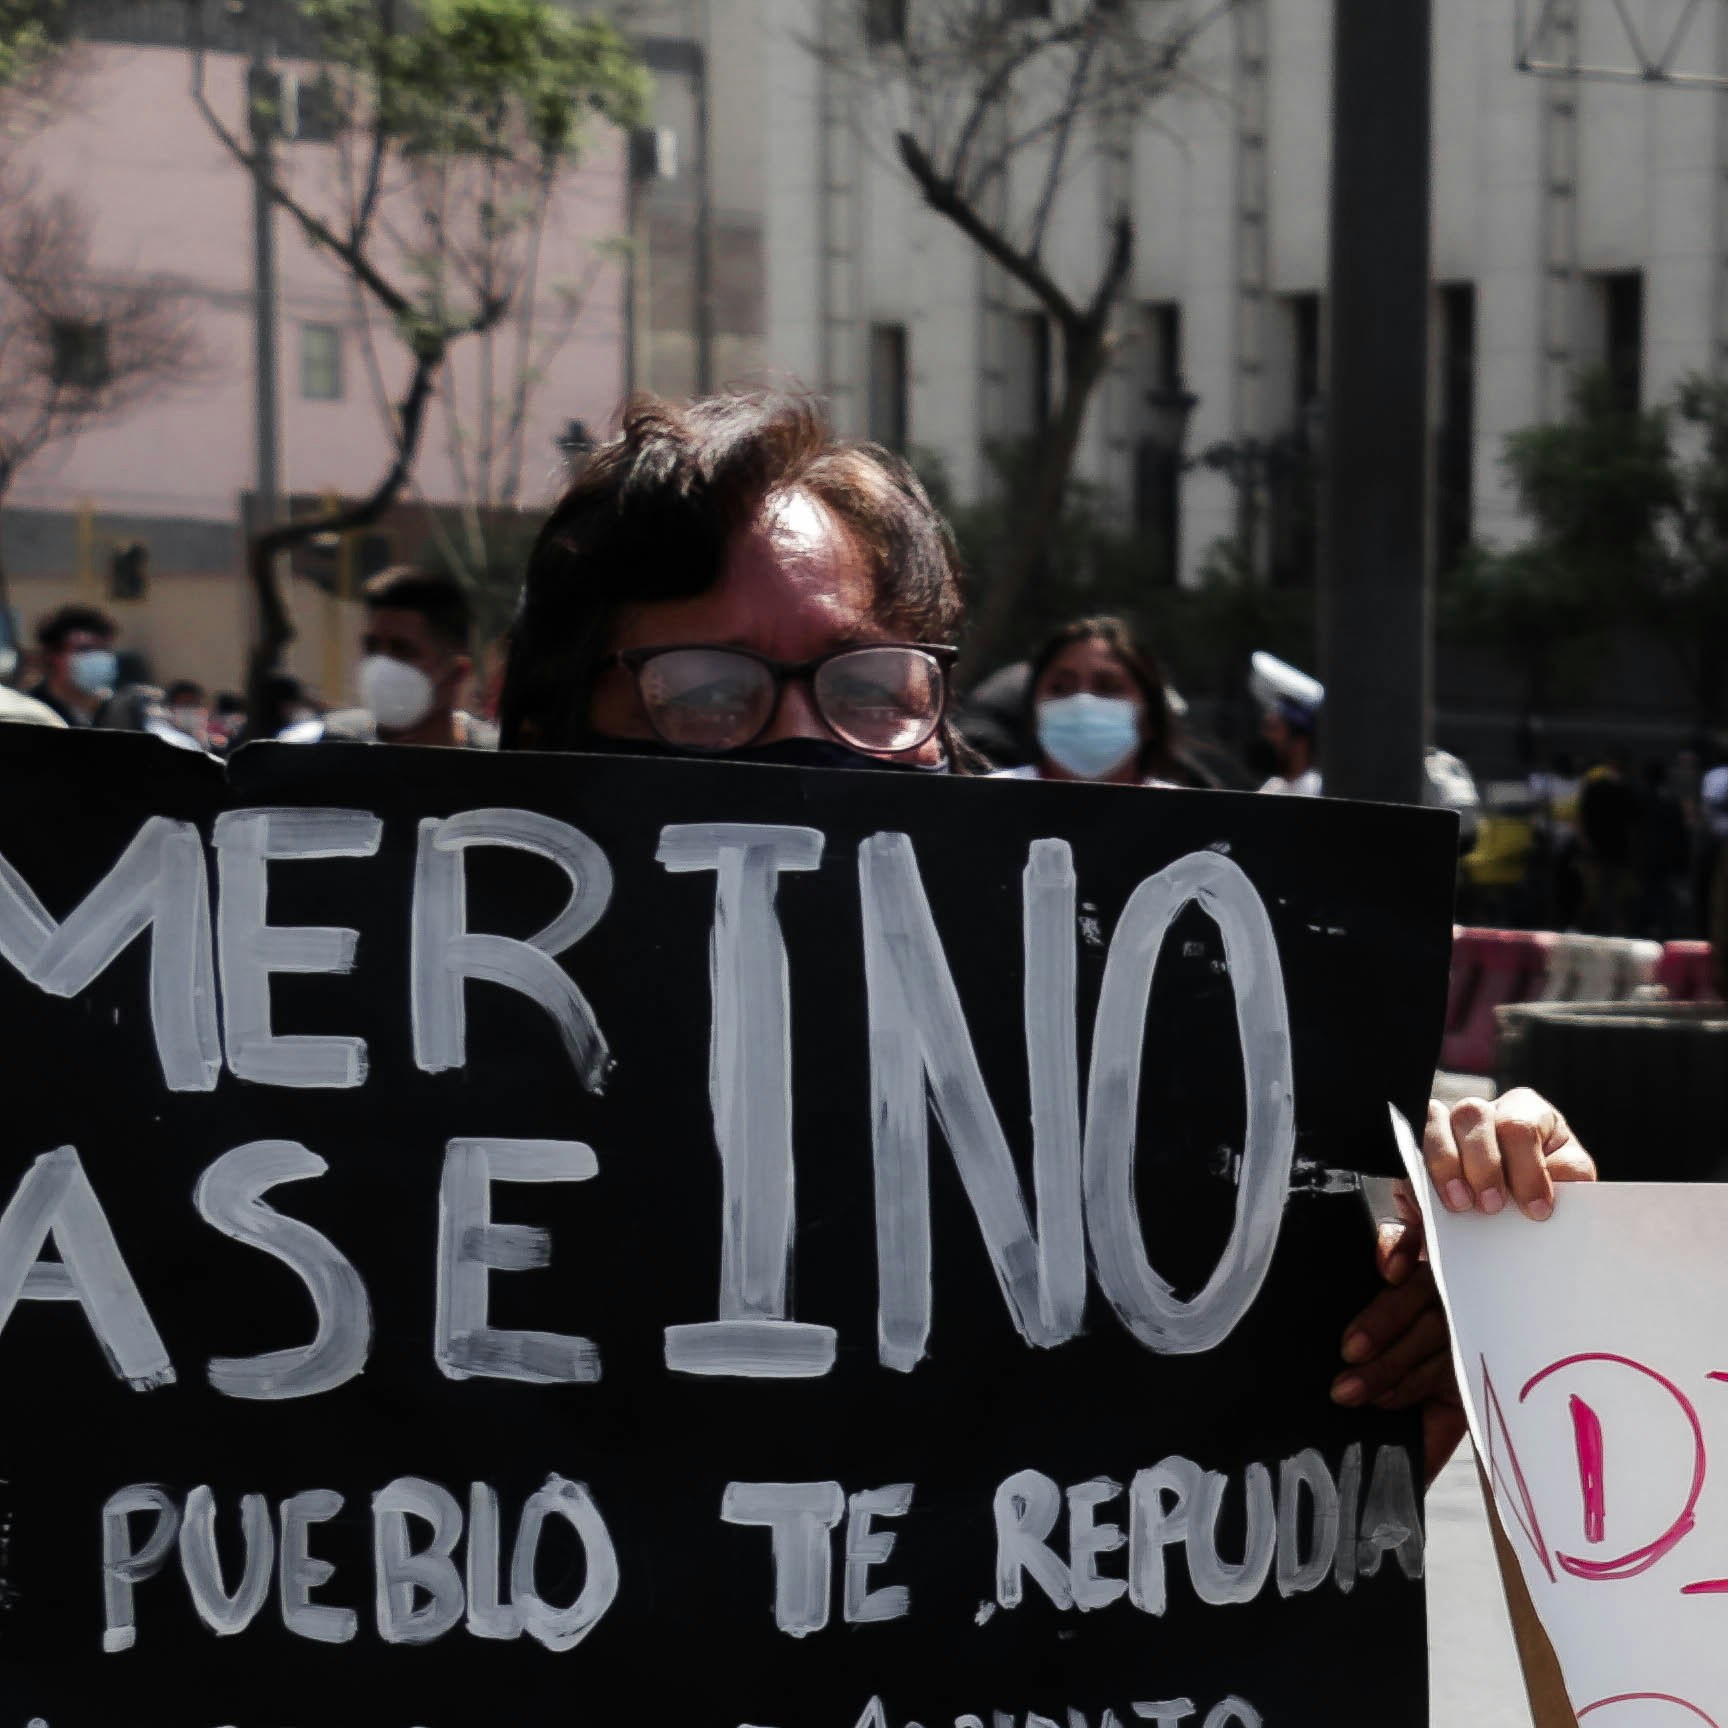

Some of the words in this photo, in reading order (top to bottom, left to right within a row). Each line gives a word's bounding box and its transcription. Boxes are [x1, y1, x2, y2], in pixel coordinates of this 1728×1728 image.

[103, 1472, 620, 1652] PUEBLO
[720, 1481, 914, 1638] TE
[993, 1442, 1424, 1616] REPUDIA
